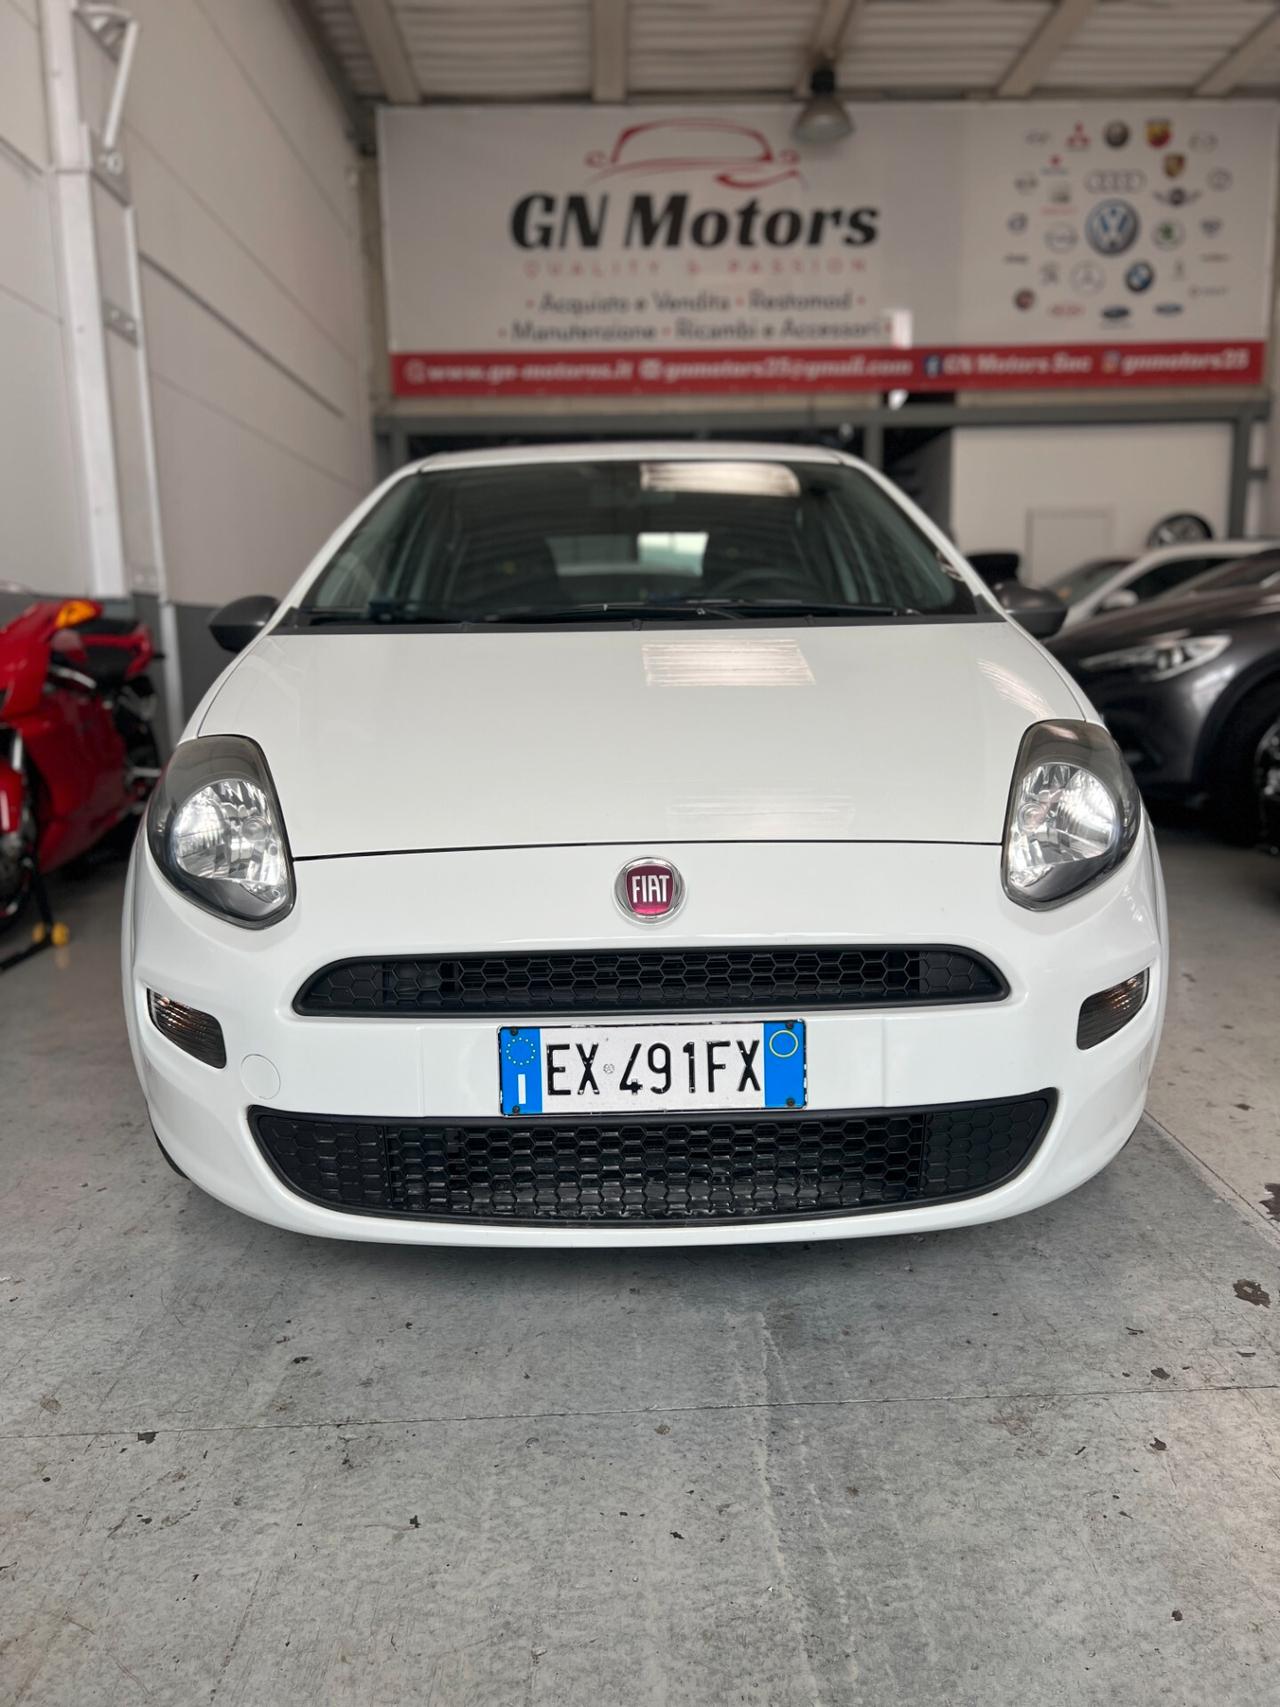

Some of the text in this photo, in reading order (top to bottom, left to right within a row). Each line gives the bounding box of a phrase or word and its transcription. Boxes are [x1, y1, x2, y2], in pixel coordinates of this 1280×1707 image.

[511, 192, 880, 249] GN Motors
[524, 259, 660, 278] QUALITY
[728, 258, 867, 275] PASSION
[538, 289, 853, 314] Acquisto e Vendita Restomod
[512, 317, 880, 341] Manutenzione Ricambi e Accessori
[977, 352, 1049, 374] Motors
[631, 874, 670, 903] FIAT
[546, 1039, 762, 1096] EX 491FX
